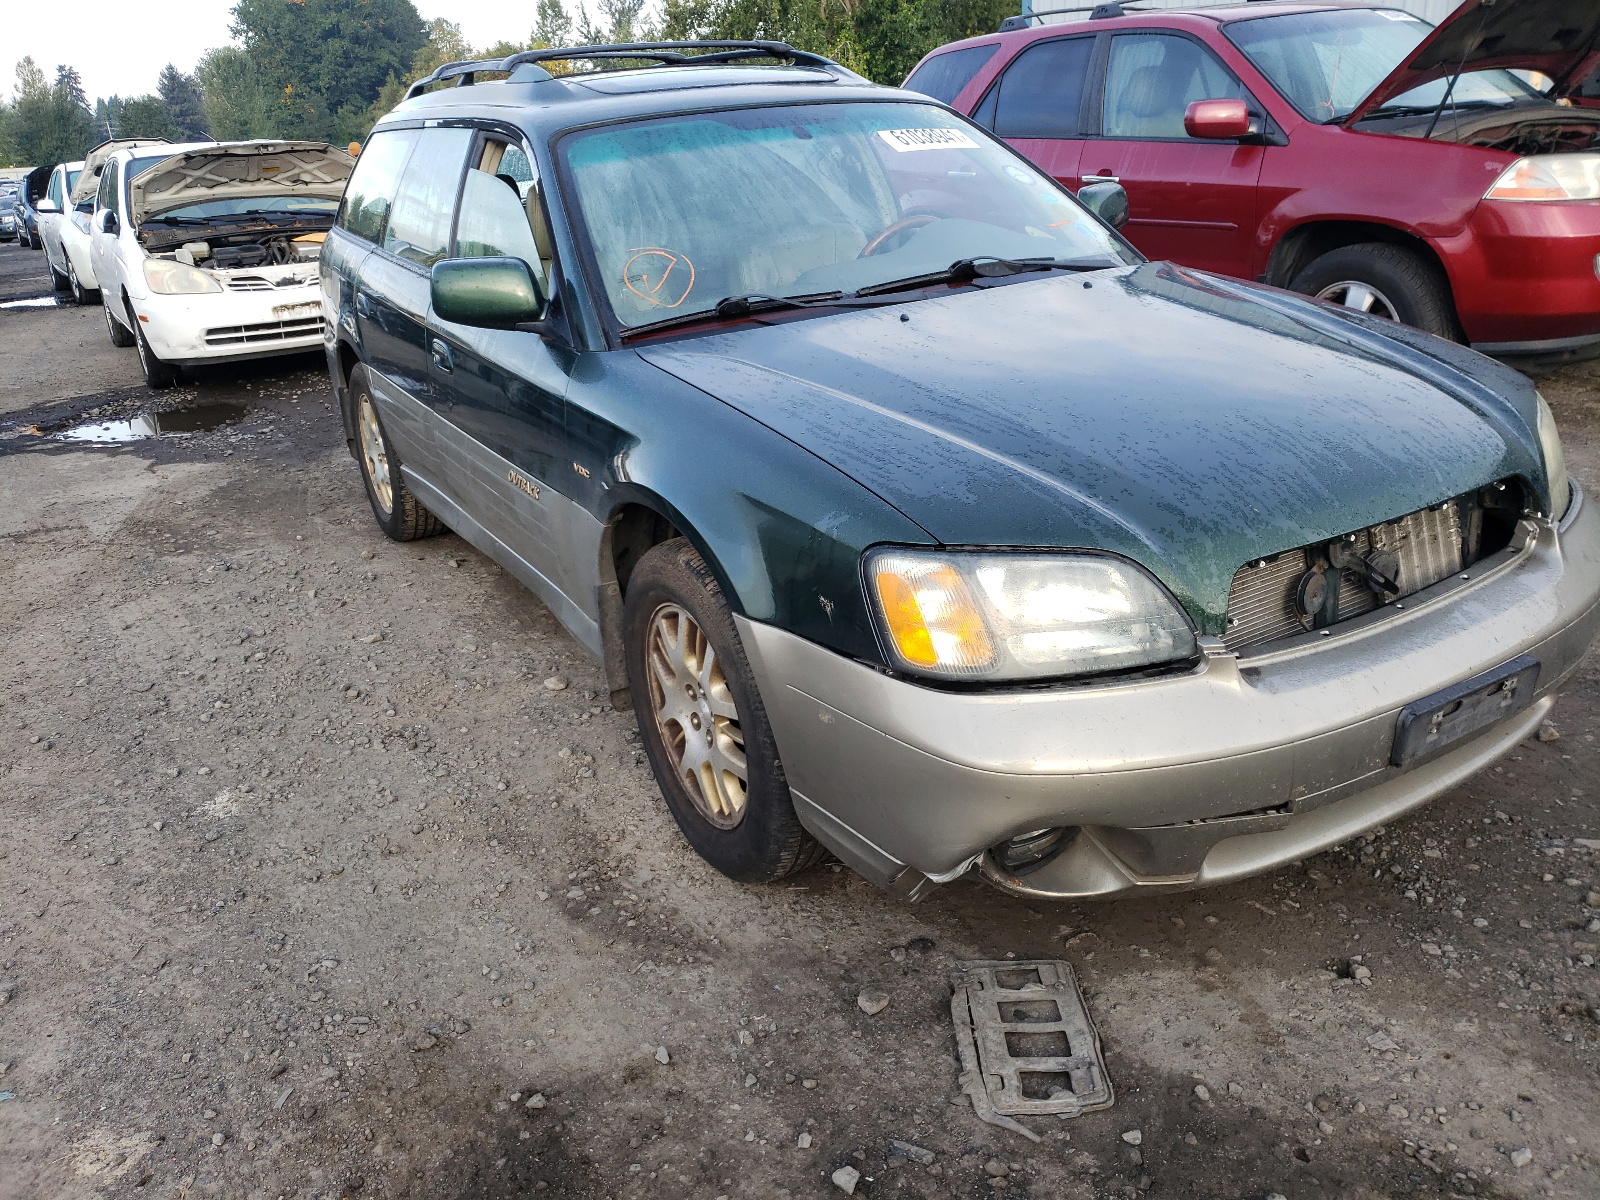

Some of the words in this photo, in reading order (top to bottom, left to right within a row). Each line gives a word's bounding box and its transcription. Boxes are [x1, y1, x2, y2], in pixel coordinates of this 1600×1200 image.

[890, 128, 964, 146] 61038941
[573, 462, 591, 479] VDC
[508, 470, 540, 500] OUTBACK
